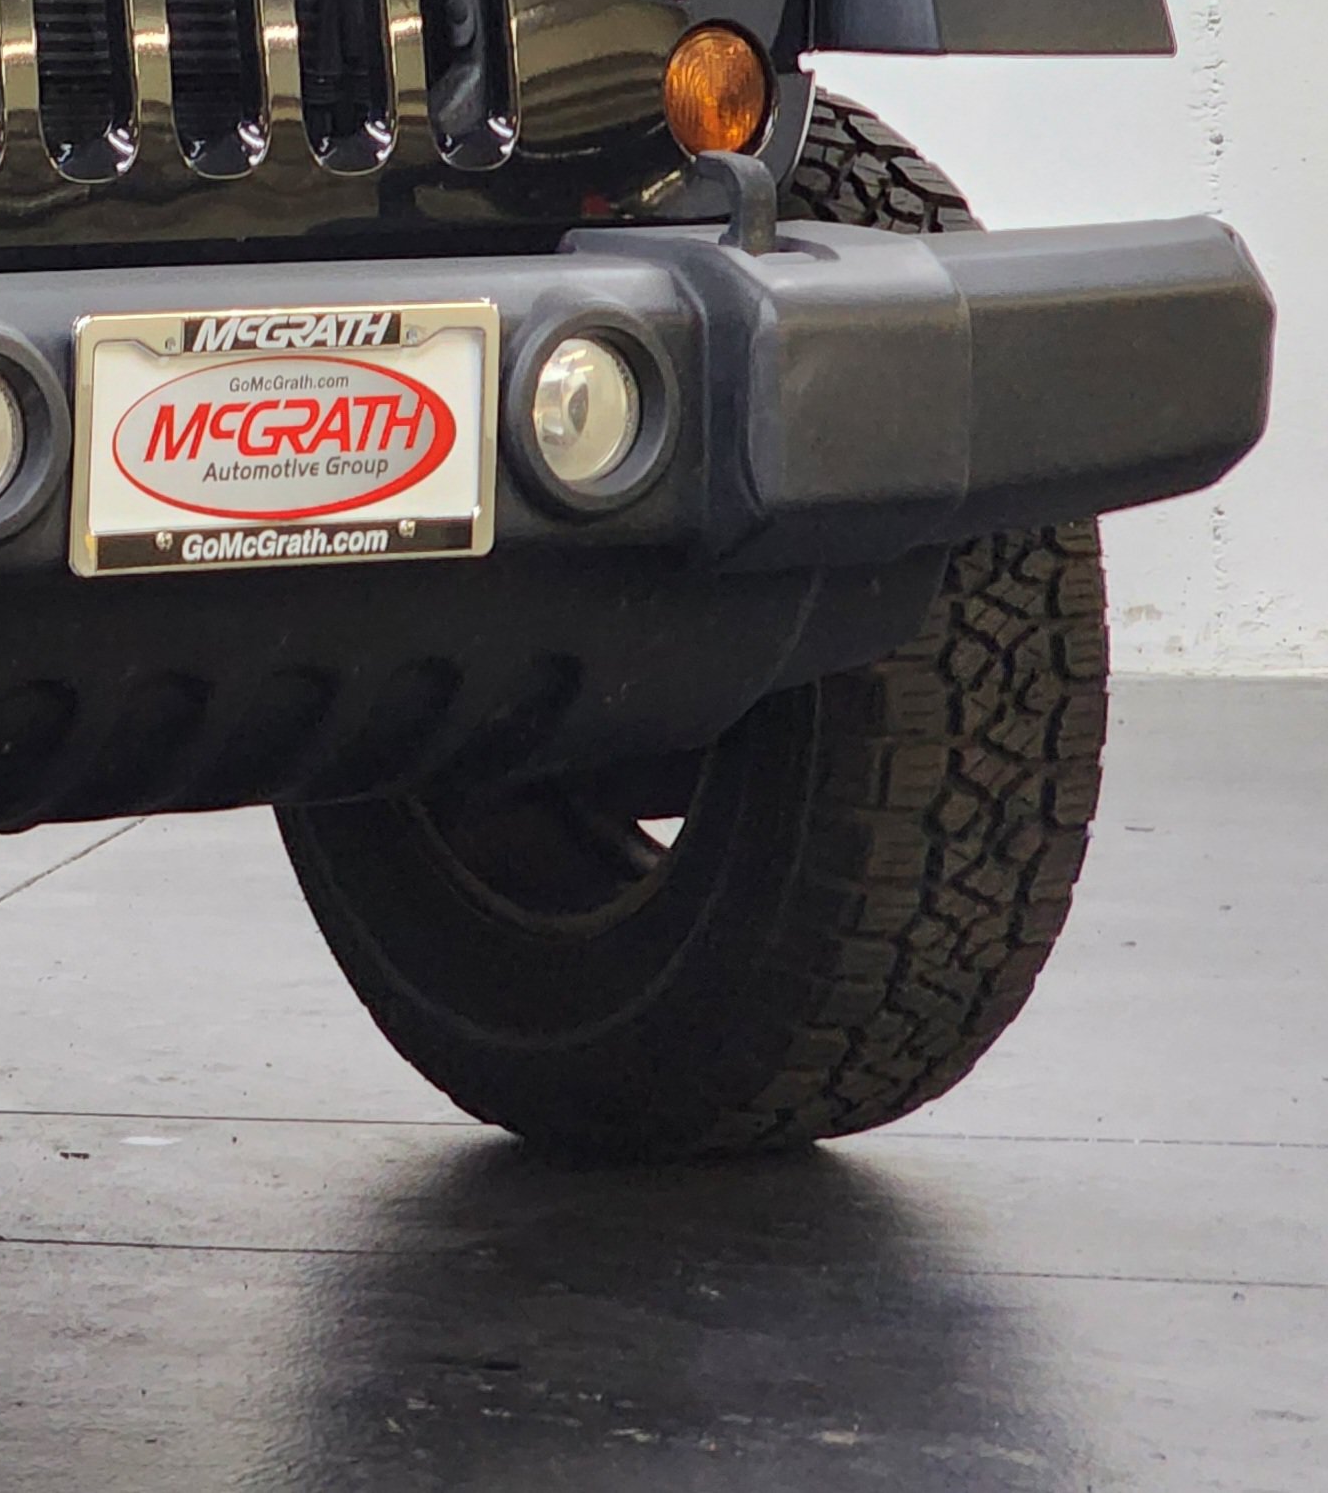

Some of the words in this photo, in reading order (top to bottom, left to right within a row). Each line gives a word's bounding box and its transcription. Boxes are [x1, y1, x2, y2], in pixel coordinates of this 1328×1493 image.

[228, 374, 350, 394] GoMcGrath.com
[202, 458, 320, 483] Automotive
[325, 454, 389, 480] Group
[182, 528, 388, 562] GoMcGrath.com
